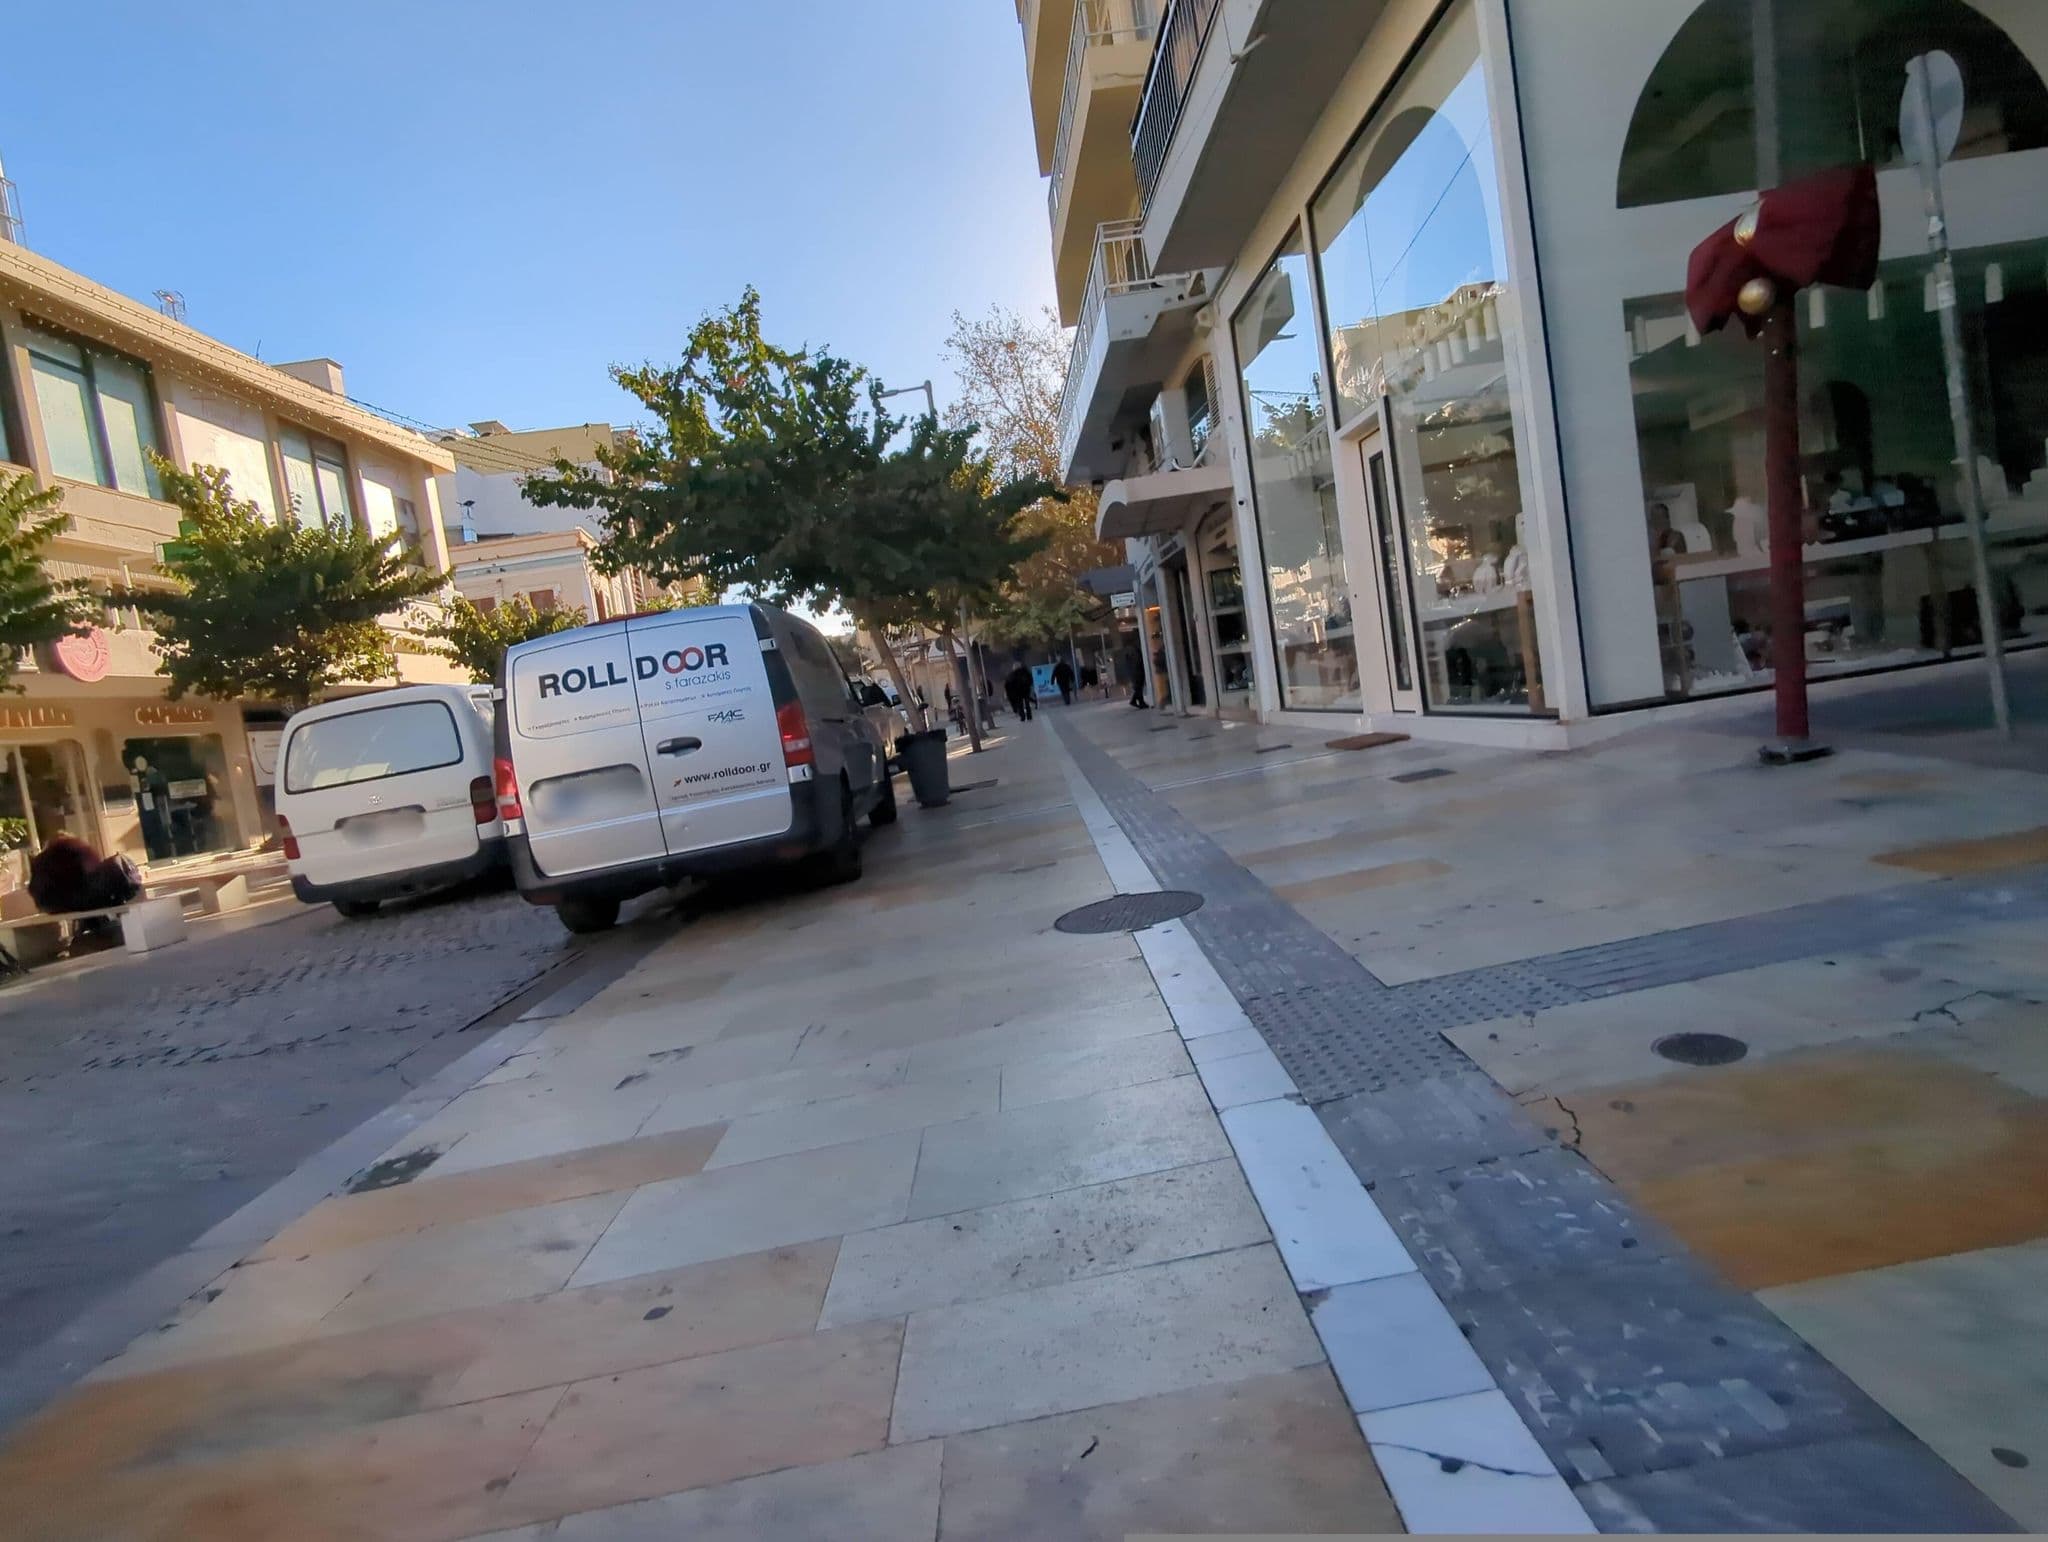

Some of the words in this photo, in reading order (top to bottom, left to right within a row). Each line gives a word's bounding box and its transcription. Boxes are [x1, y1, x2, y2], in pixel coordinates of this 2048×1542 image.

[538, 662, 628, 698] ROLL
[635, 643, 729, 680] DOOR
[707, 709, 744, 722] FAAC
[684, 762, 771, 783] www.rolldoor.gr
